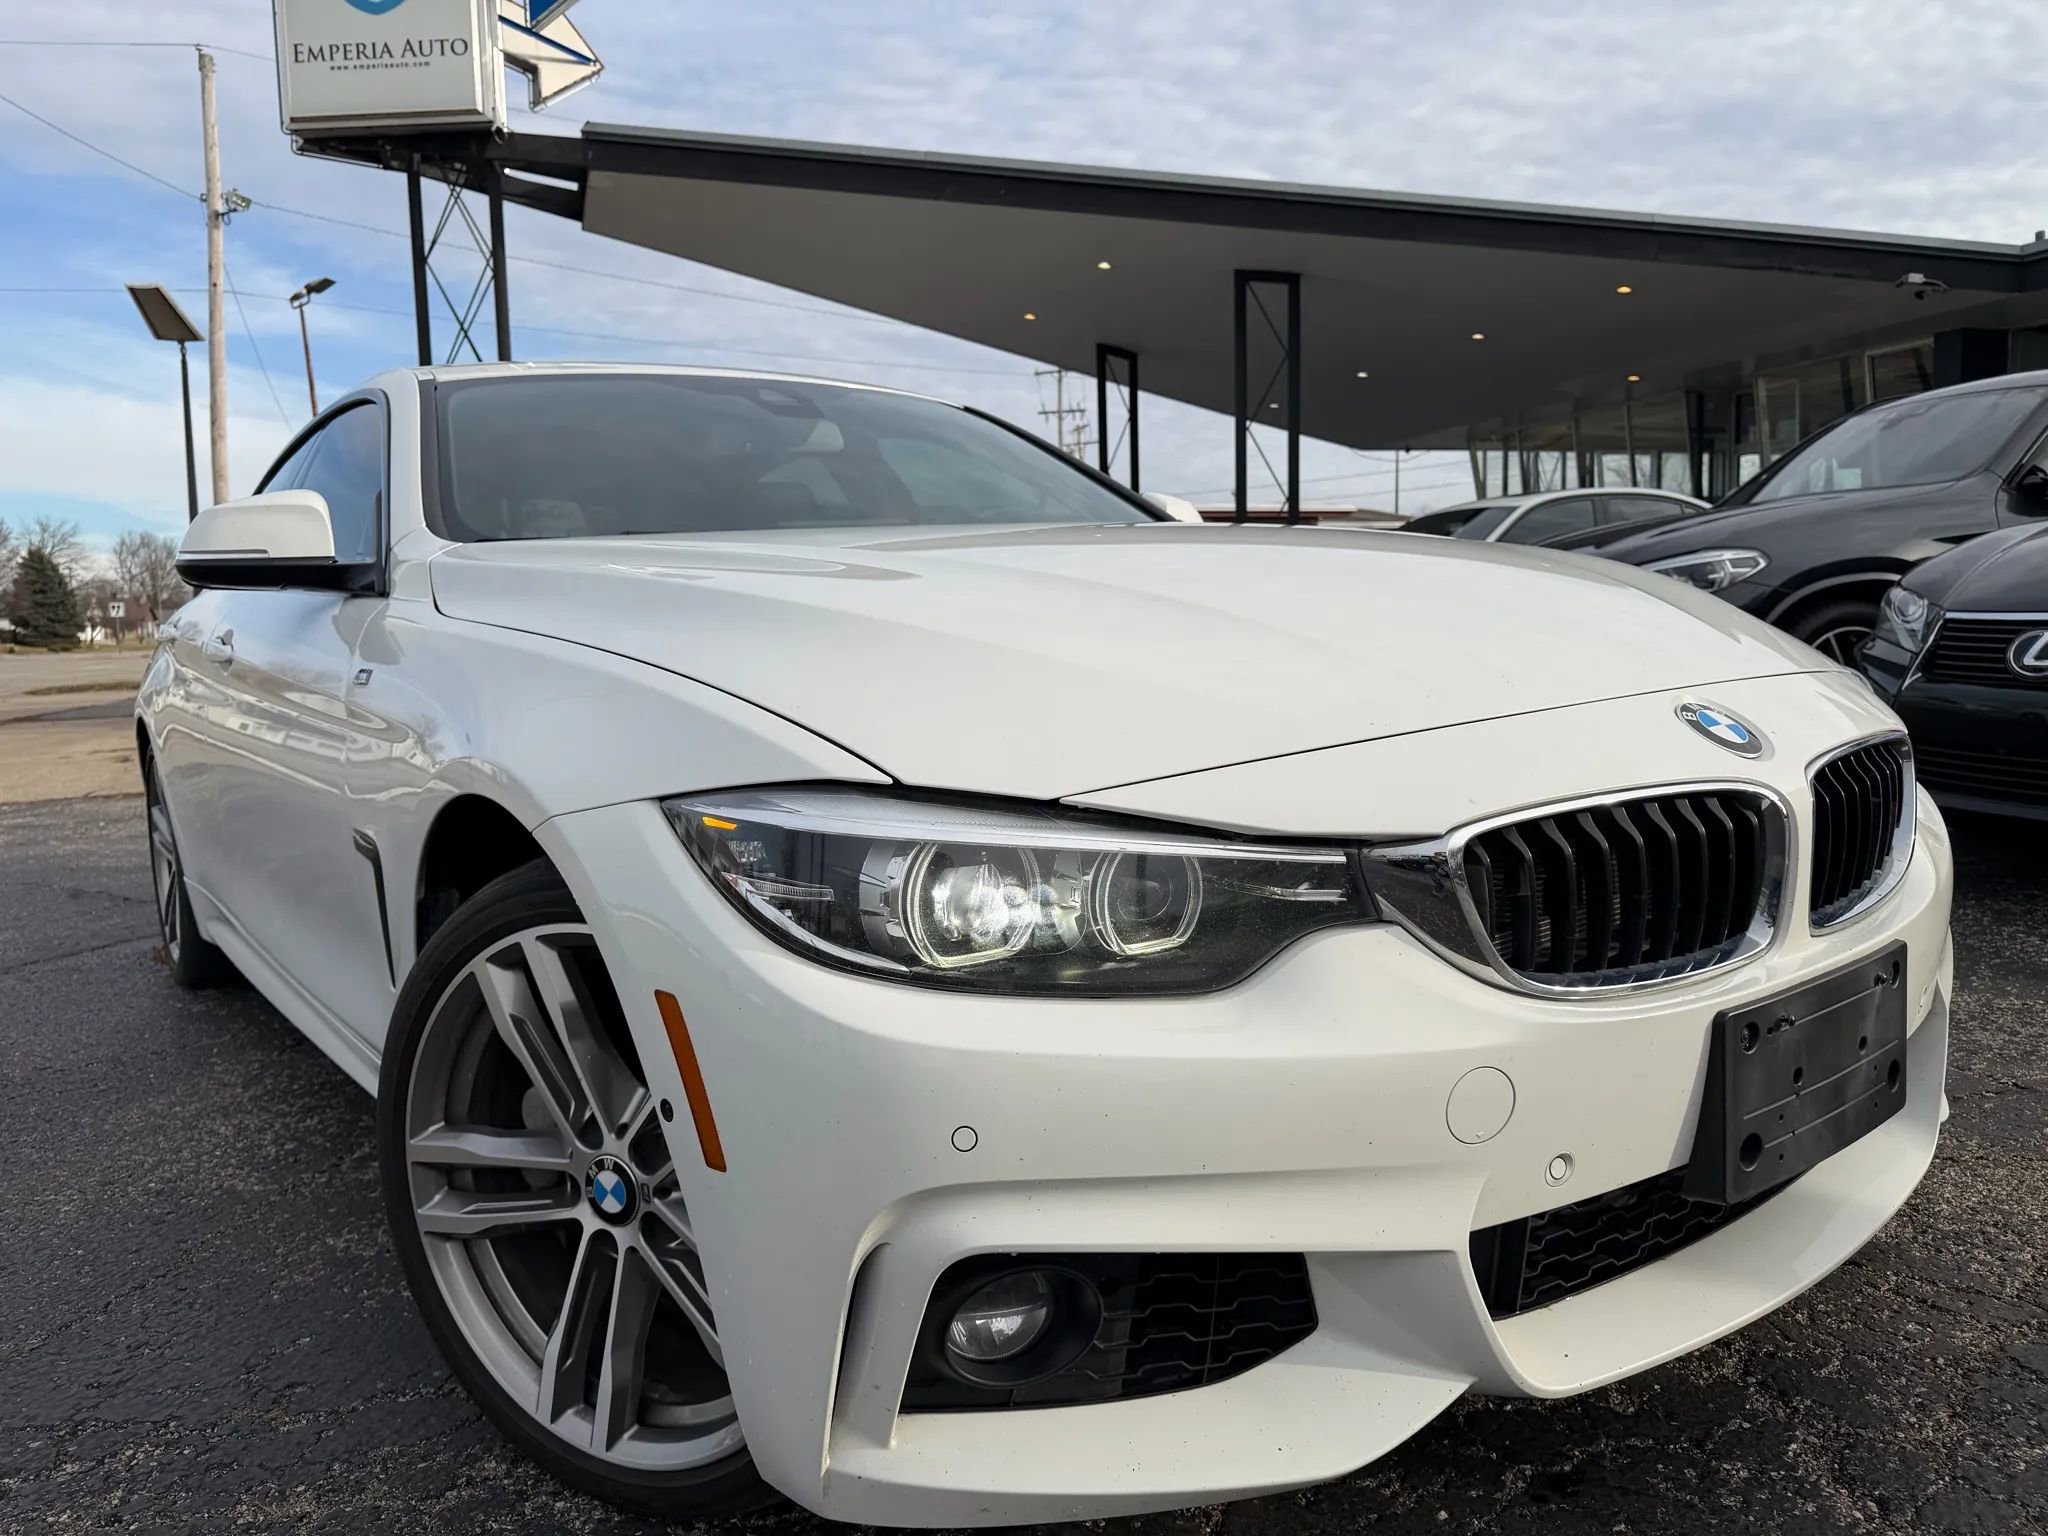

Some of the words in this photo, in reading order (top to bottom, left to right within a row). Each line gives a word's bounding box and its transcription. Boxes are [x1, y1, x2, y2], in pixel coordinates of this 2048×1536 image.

[293, 42, 394, 63] EMPERIA
[401, 38, 468, 58] AUTO
[330, 60, 431, 71] www.emperiaauto.com
